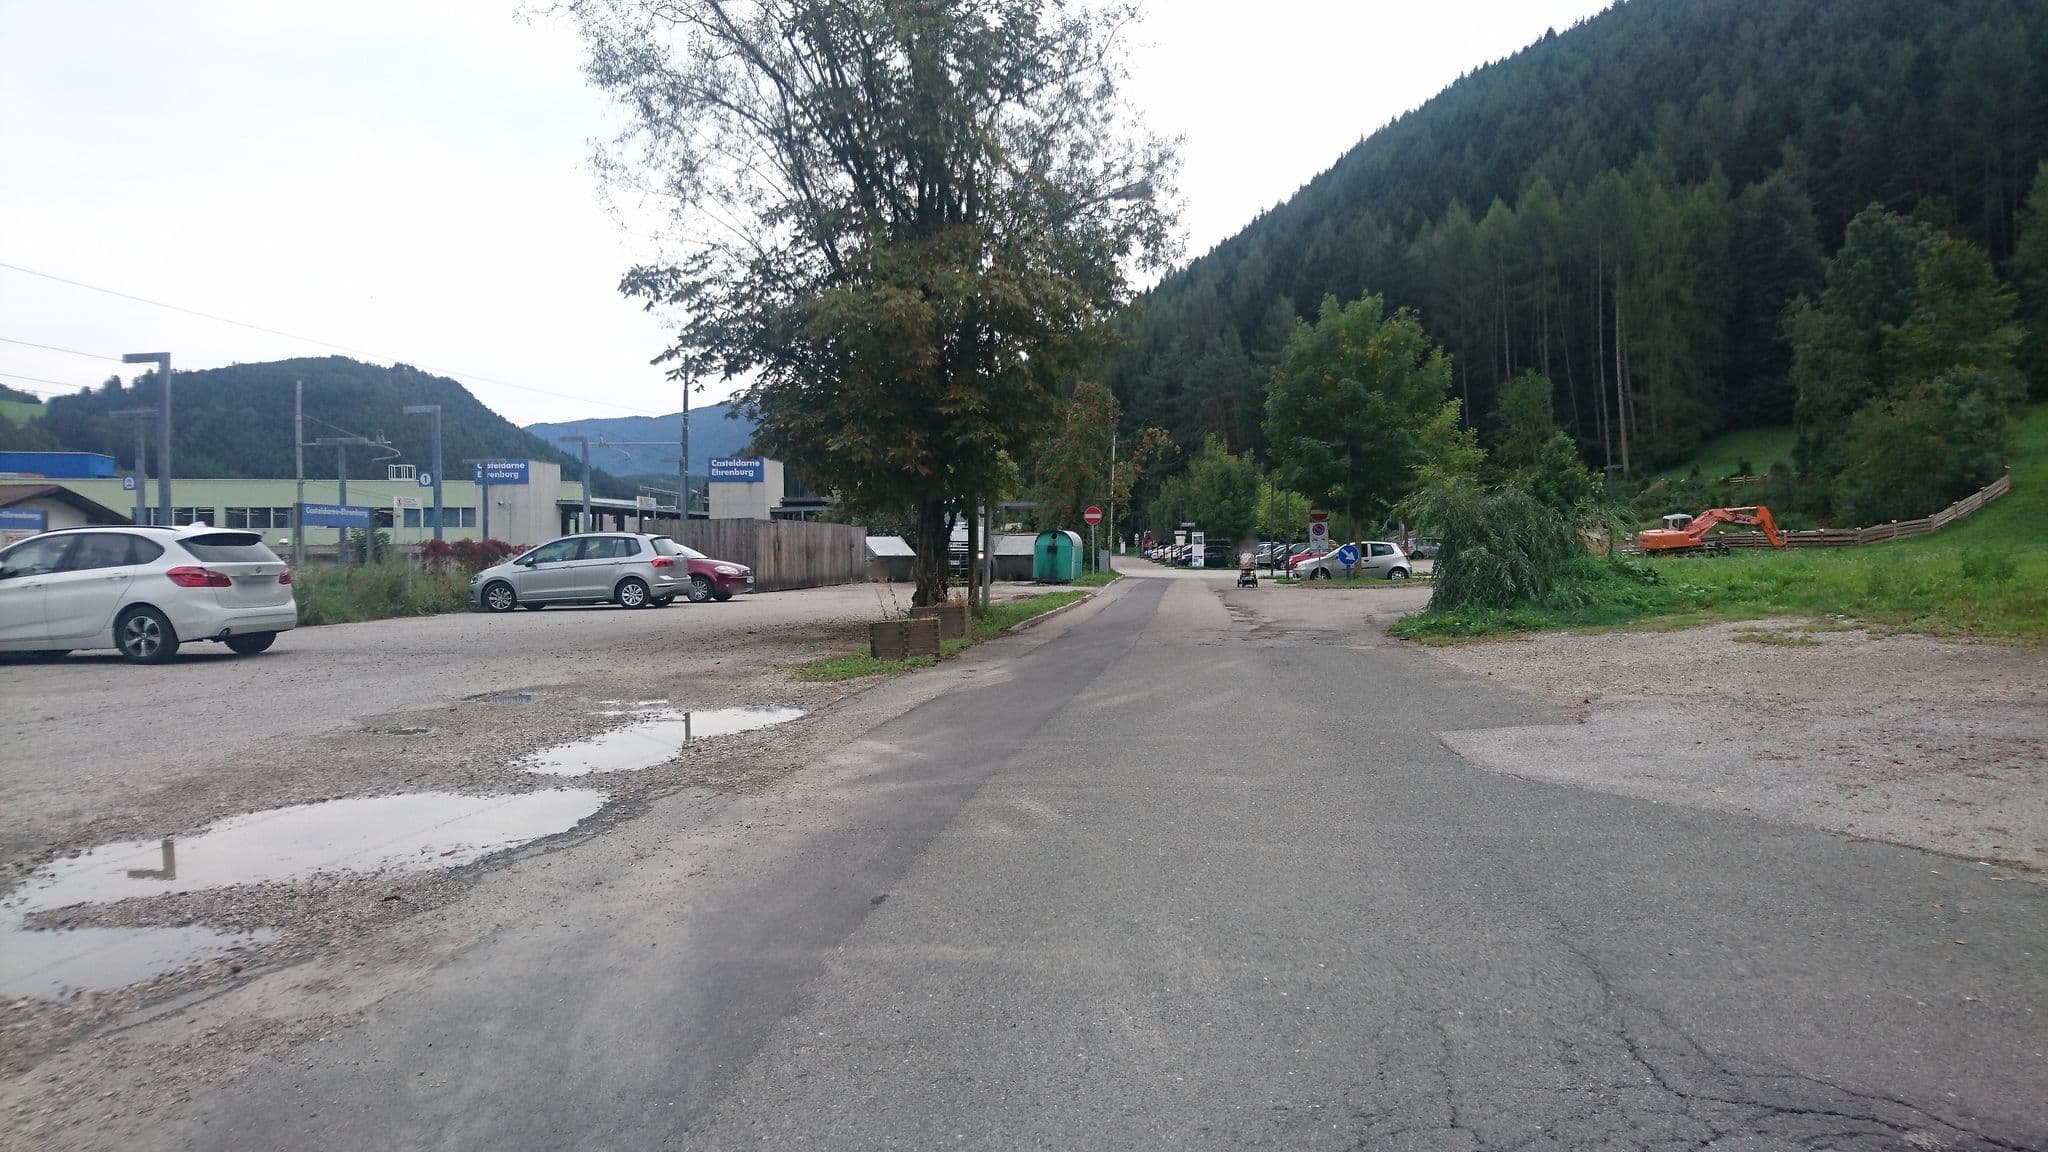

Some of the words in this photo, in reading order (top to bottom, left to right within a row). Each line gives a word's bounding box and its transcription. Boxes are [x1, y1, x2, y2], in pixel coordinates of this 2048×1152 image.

[711, 459, 760, 467] Casteldarne
[477, 470, 519, 479] Erenburg
[711, 468, 754, 477] Ehrenburg
